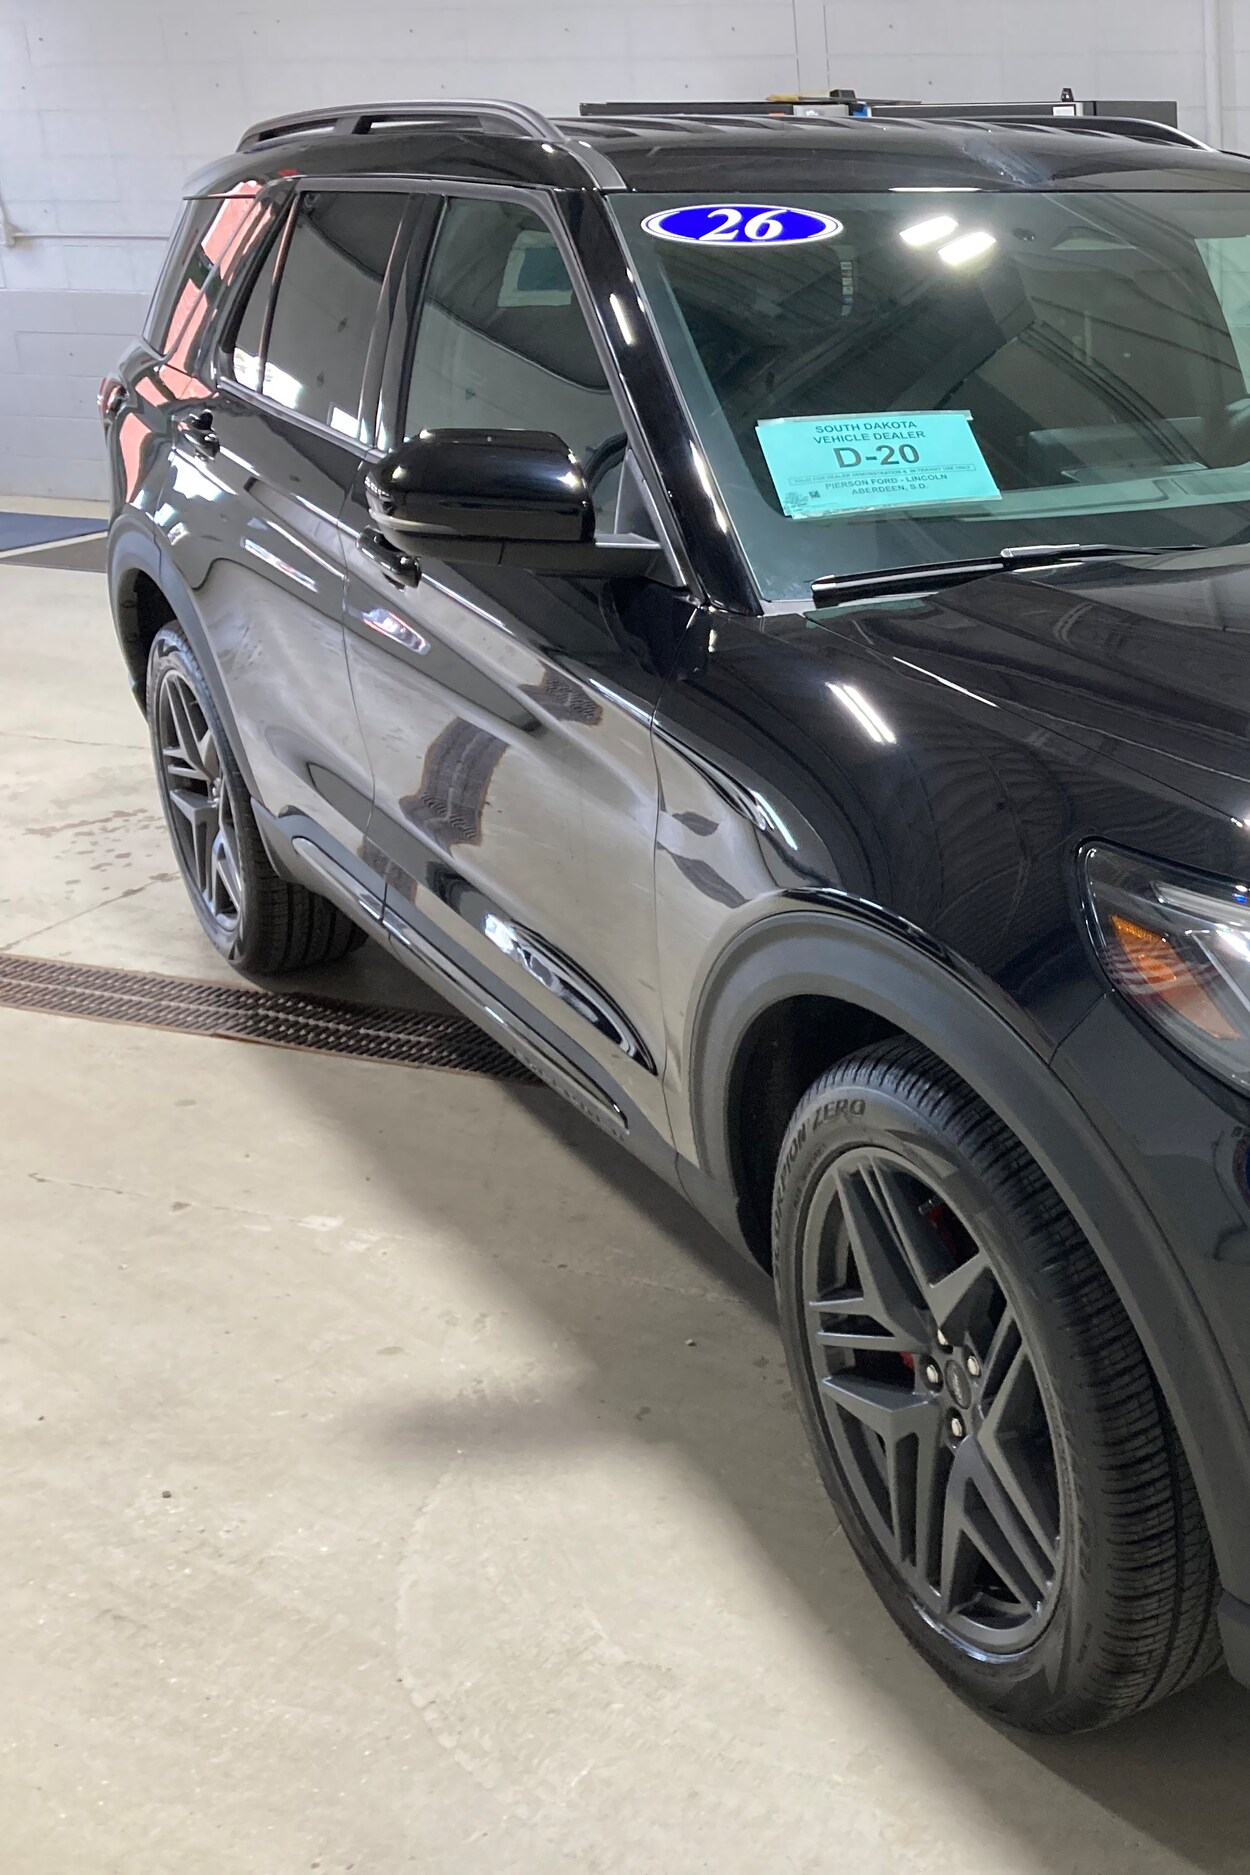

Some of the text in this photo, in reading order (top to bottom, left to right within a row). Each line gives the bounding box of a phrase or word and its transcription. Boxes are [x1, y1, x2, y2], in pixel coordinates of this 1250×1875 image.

[698, 208, 788, 241] 26
[815, 420, 917, 434] SOUTH DAKOTA
[812, 430, 926, 445] VEHICLE DEALER
[832, 443, 920, 469] D-20
[825, 479, 869, 490] PIERSON
[871, 477, 898, 486] FORD
[905, 474, 948, 483] LINCOLN
[851, 483, 929, 495] ABERDEEN, S.D.
[813, 1098, 866, 1132] ZERO
